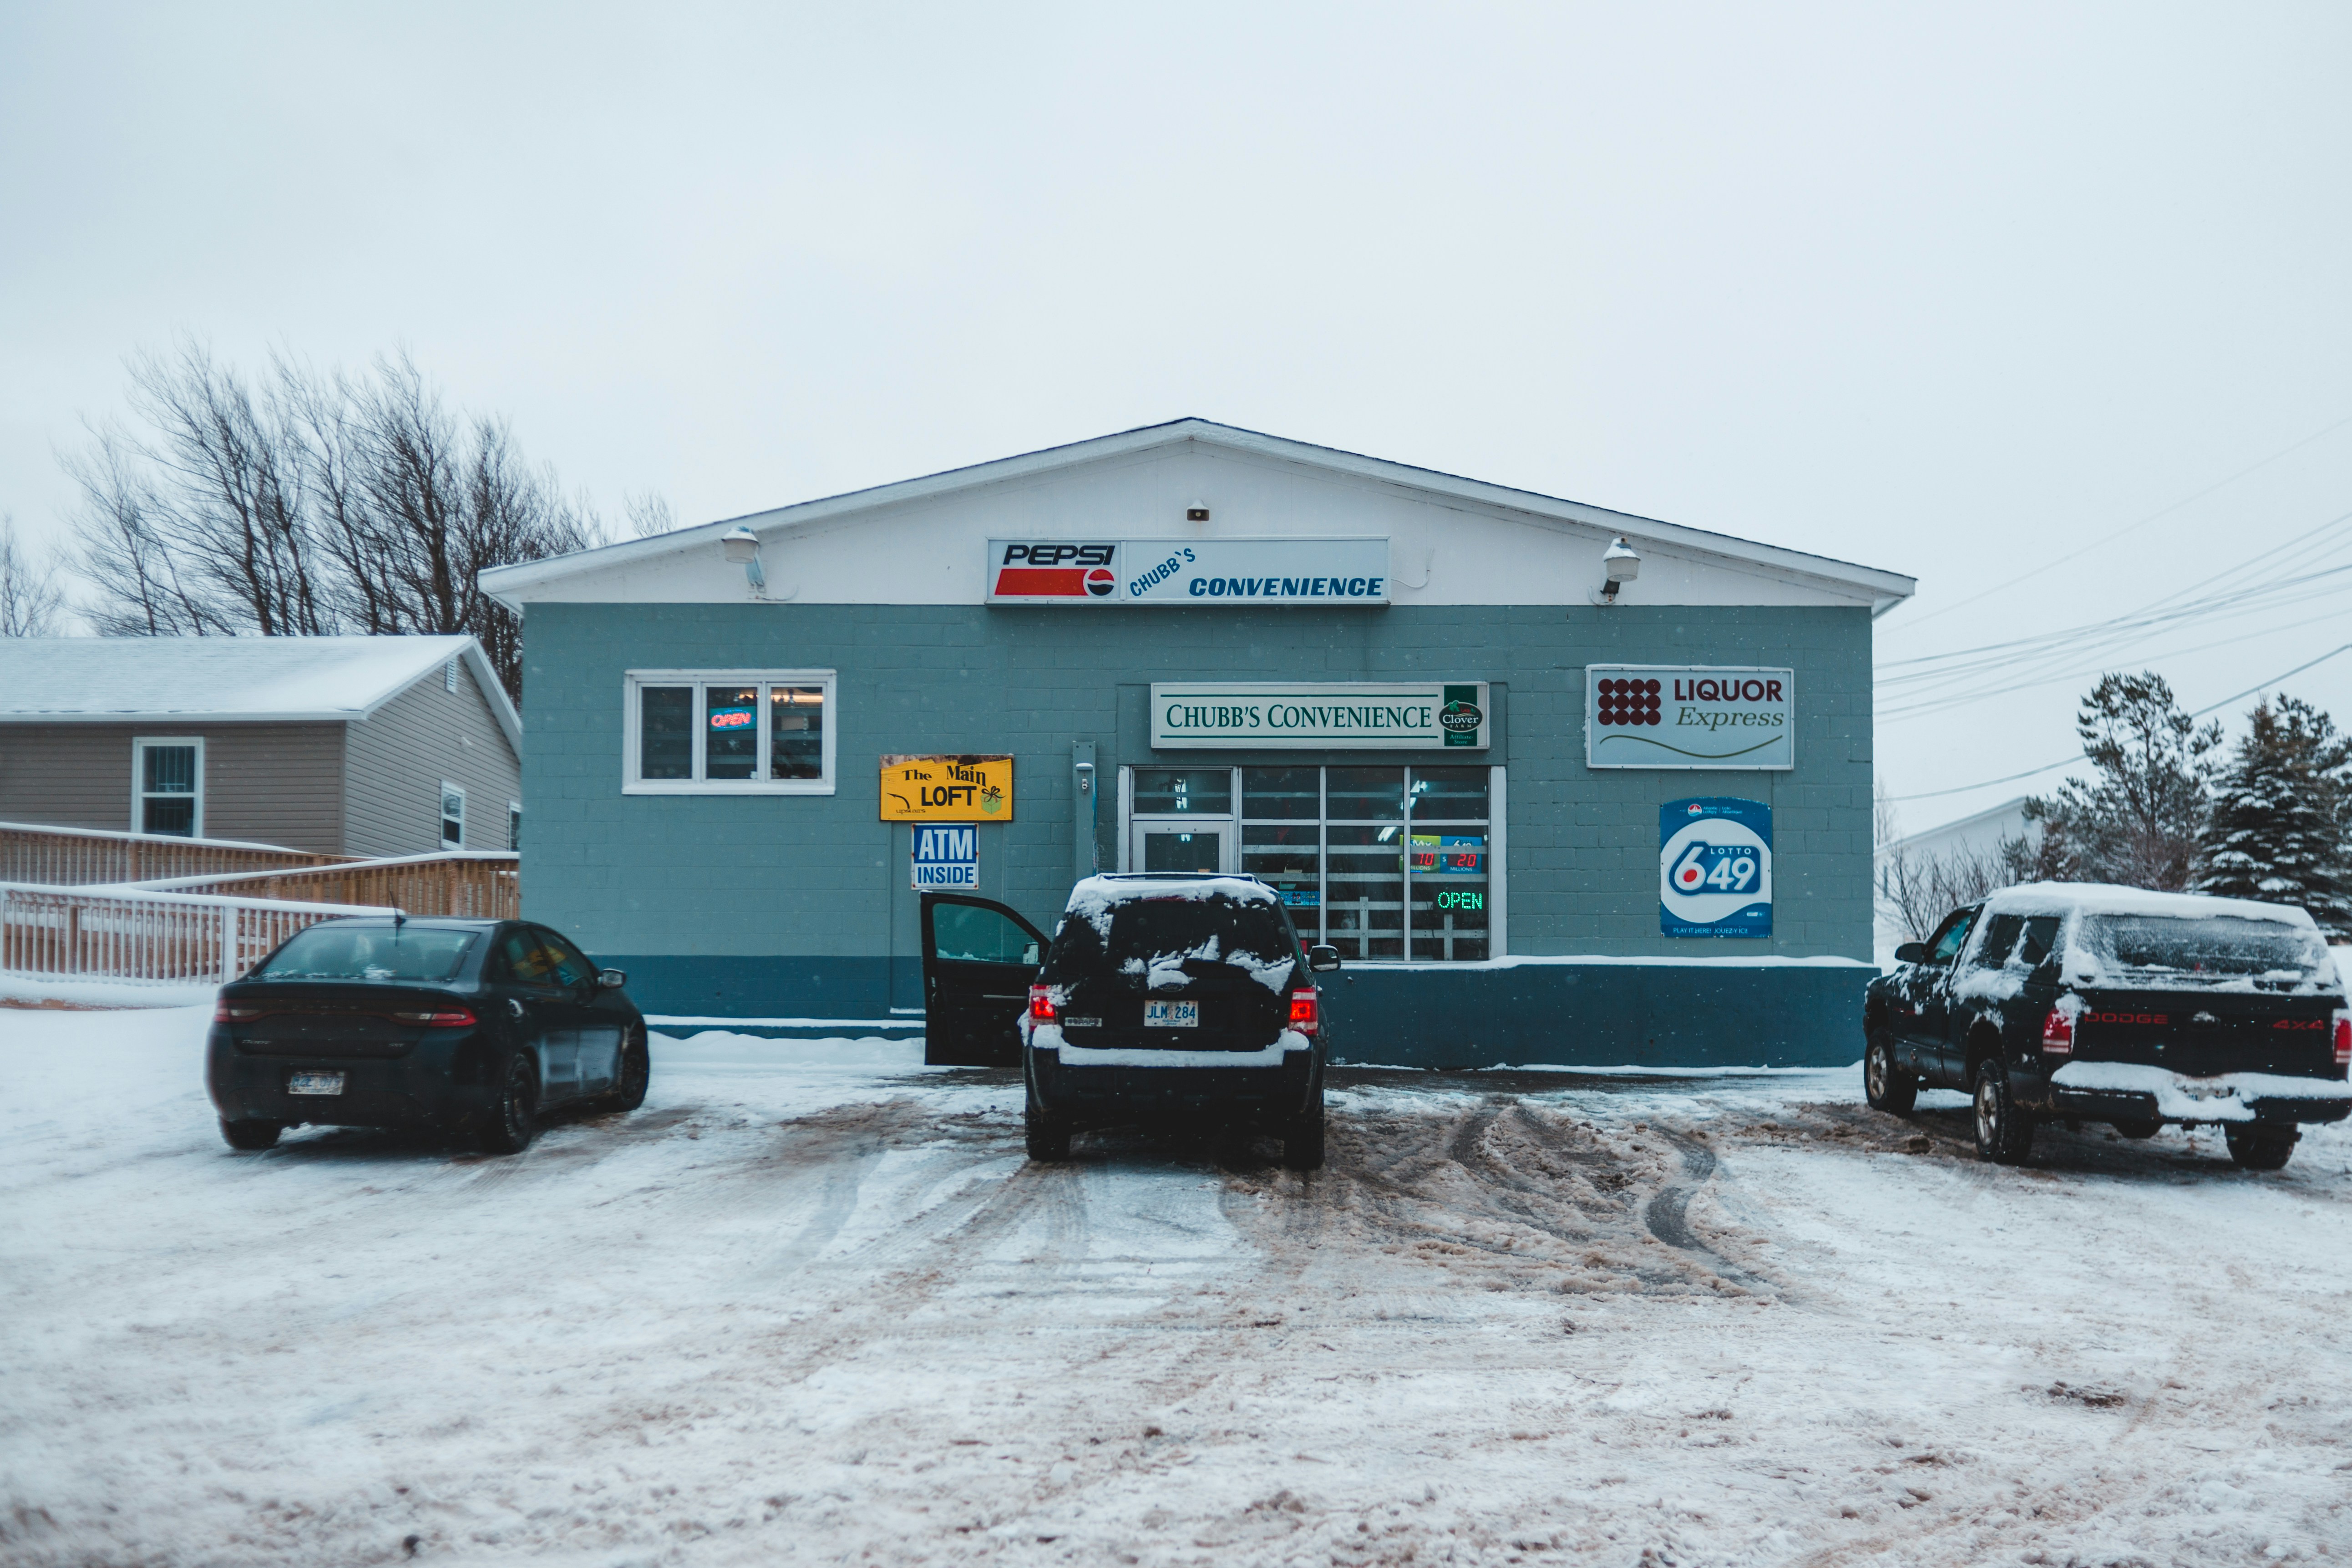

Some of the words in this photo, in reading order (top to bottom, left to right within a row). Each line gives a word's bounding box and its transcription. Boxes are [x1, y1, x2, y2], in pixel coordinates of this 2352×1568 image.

[1003, 545, 1115, 565] PEPSI
[1130, 548, 1196, 597] CHUBB'S
[1189, 578, 1384, 596] CONVENIENCE
[1674, 679, 1783, 701] LIQUOR
[711, 712, 751, 728] OPEN
[1166, 704, 1260, 728] CHUBB'S
[1267, 704, 1432, 728] CONVENIENCE
[1442, 714, 1479, 724] Clover
[1676, 706, 1784, 731] Express
[902, 769, 932, 781] The
[947, 765, 987, 787] Main
[921, 786, 977, 806] LOFT
[918, 829, 973, 860] ATM
[1457, 854, 1477, 867] 20
[918, 867, 974, 883] INSIDE
[1437, 891, 1483, 910] OPEN
[1147, 1006, 1168, 1019] JLM
[1175, 1006, 1196, 1019] 284
[2084, 1012, 2169, 1024] DODGE
